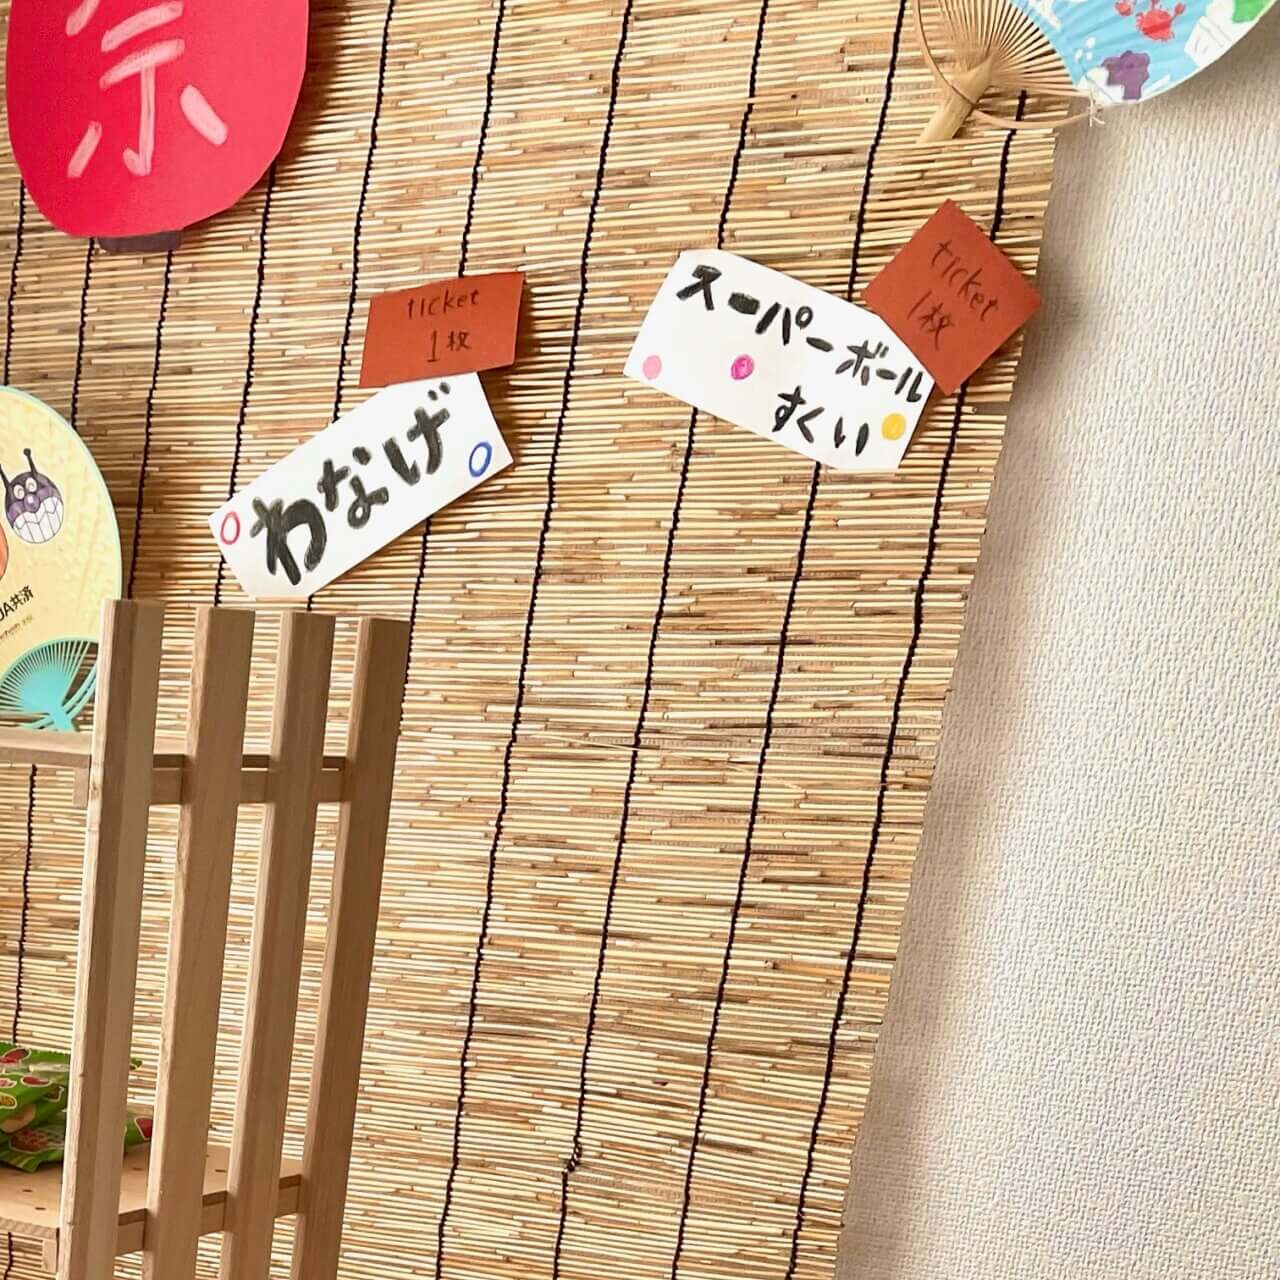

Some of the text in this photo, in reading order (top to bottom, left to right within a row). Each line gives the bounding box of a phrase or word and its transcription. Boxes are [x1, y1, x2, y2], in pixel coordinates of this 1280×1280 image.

[407, 289, 480, 320] ticket
[931, 240, 998, 322] ticket
[676, 264, 923, 403] スーパーボール
[772, 385, 870, 457] すくい
[250, 382, 451, 586] わなげ
